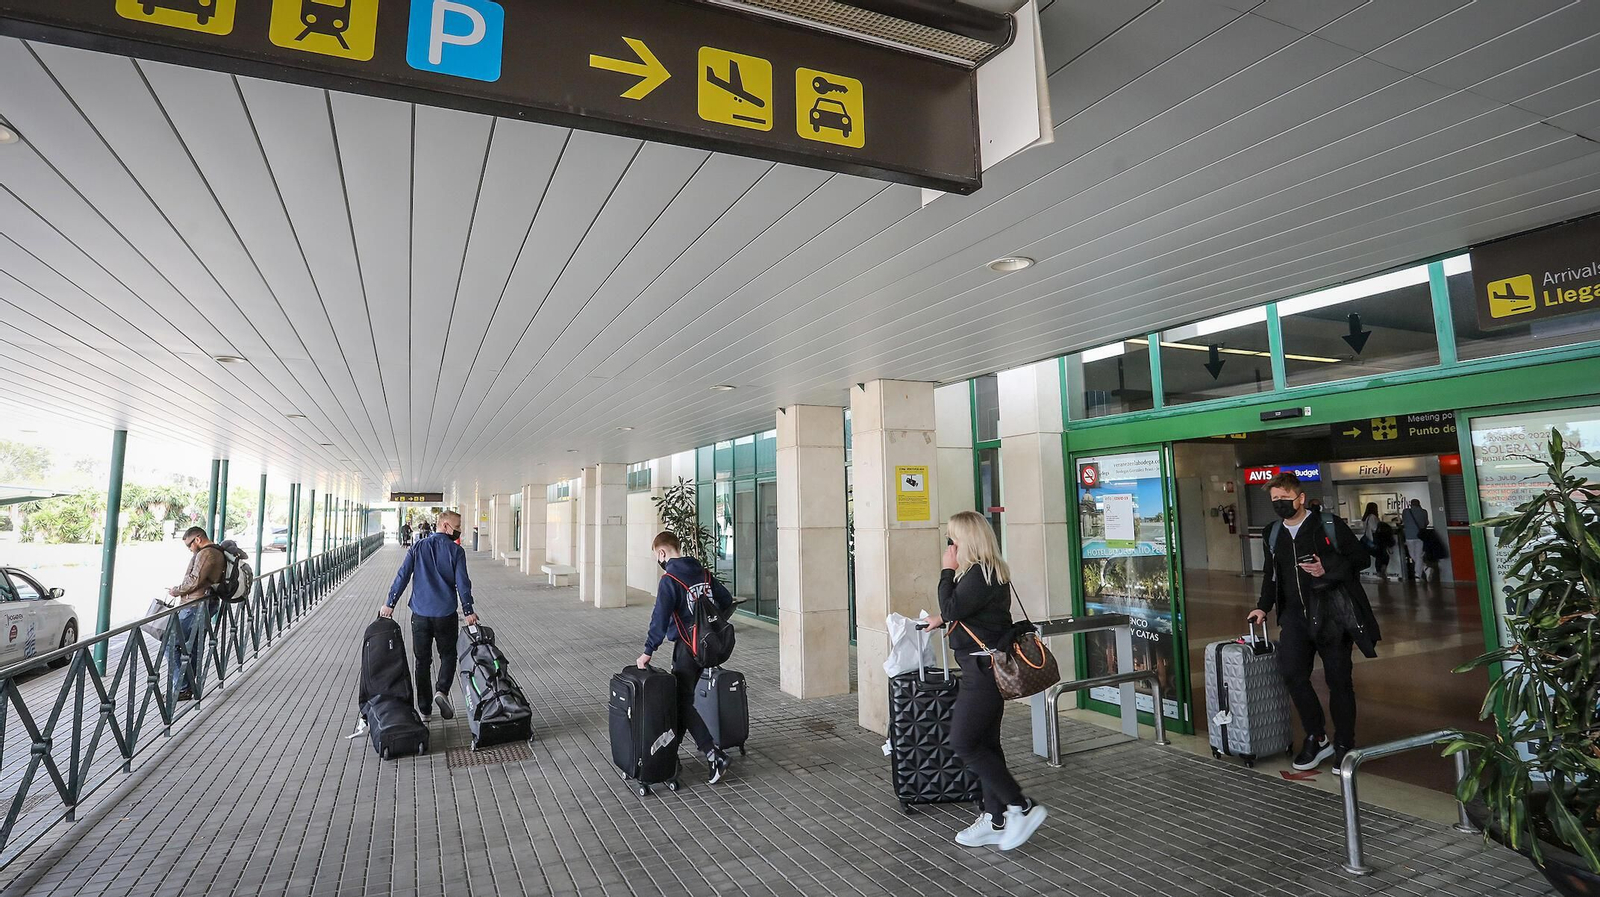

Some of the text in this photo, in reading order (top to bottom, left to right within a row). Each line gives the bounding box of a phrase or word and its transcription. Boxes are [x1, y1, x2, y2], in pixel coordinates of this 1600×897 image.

[428, 0, 486, 65] P
[1407, 413, 1440, 422] Meeting
[1409, 424, 1456, 436] Punto de
[1481, 443, 1531, 455] SOLERA
[1535, 442, 1544, 451] Y
[1249, 470, 1272, 481] AVIS
[1294, 469, 1319, 478] Budget
[1359, 463, 1392, 476] Firefly
[1087, 549, 1107, 557] HOTEL
[1130, 628, 1159, 642] Y CATAS
